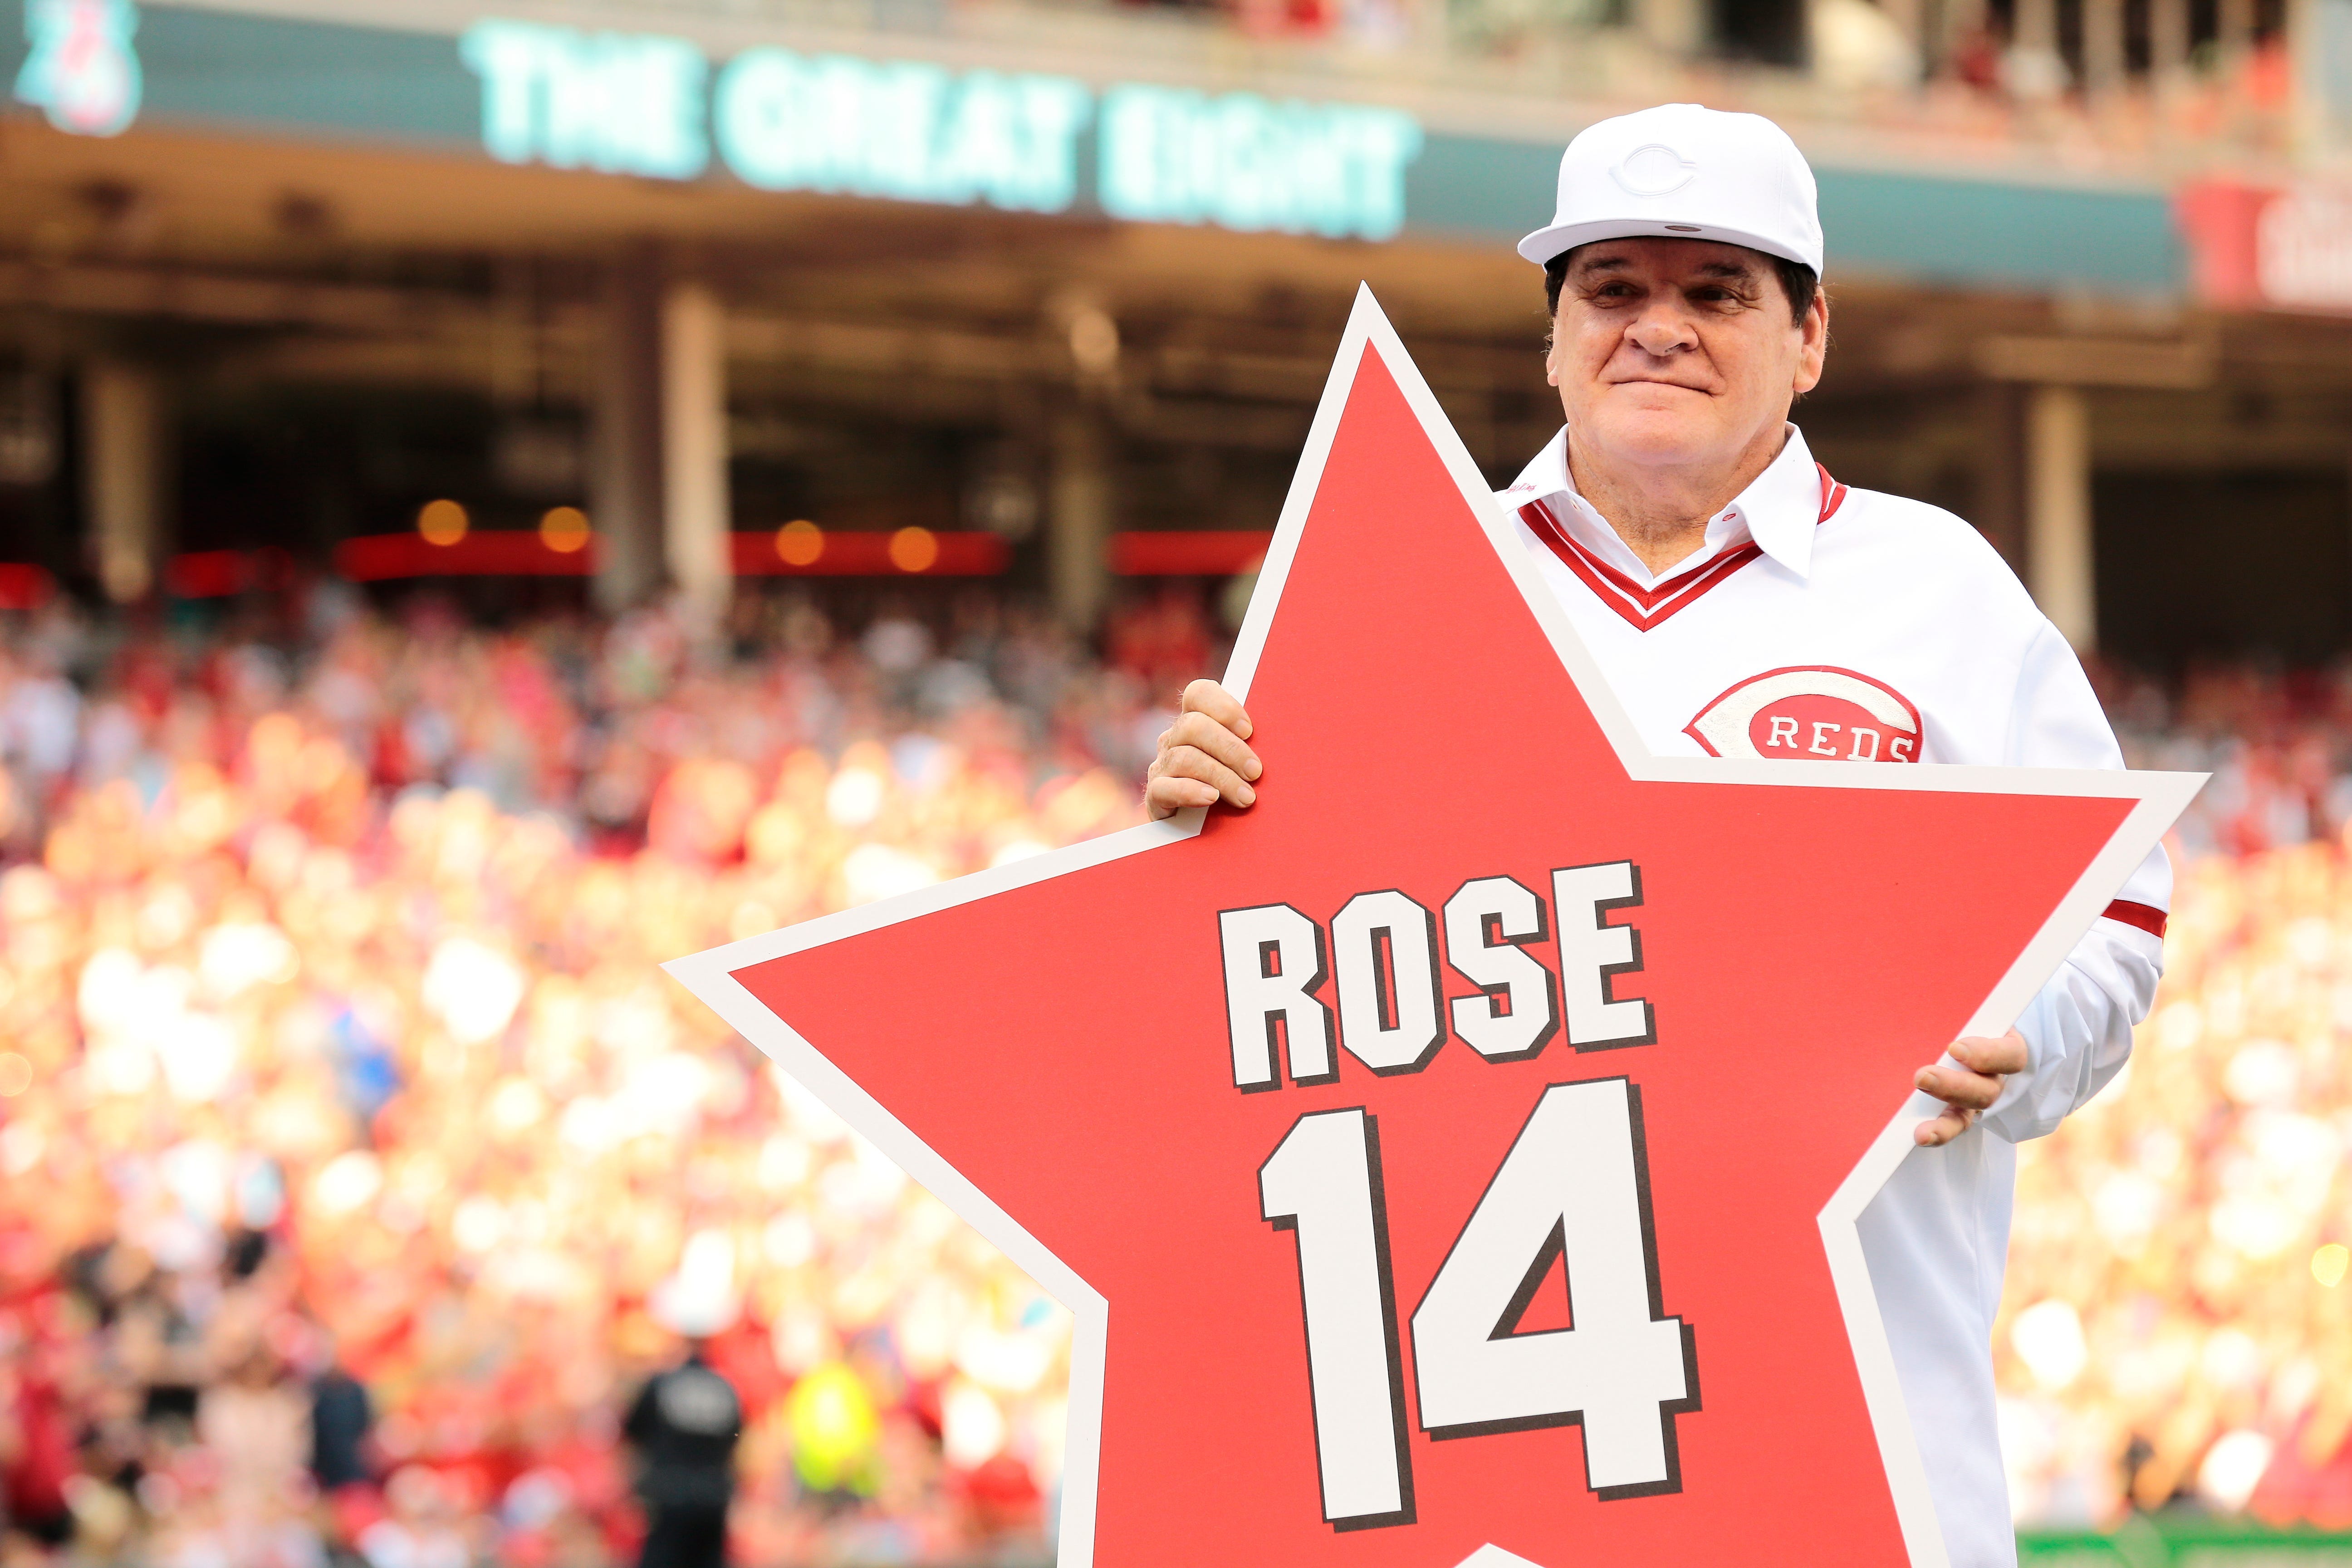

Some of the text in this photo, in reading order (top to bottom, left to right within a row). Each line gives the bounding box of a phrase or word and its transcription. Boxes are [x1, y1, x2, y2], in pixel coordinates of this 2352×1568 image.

[460, 18, 1422, 242] THE GREAT EIGHT
[1766, 715, 1913, 763] REDS
[1217, 859, 1658, 1094] ROSE
[1257, 1075, 1703, 1534] 14
